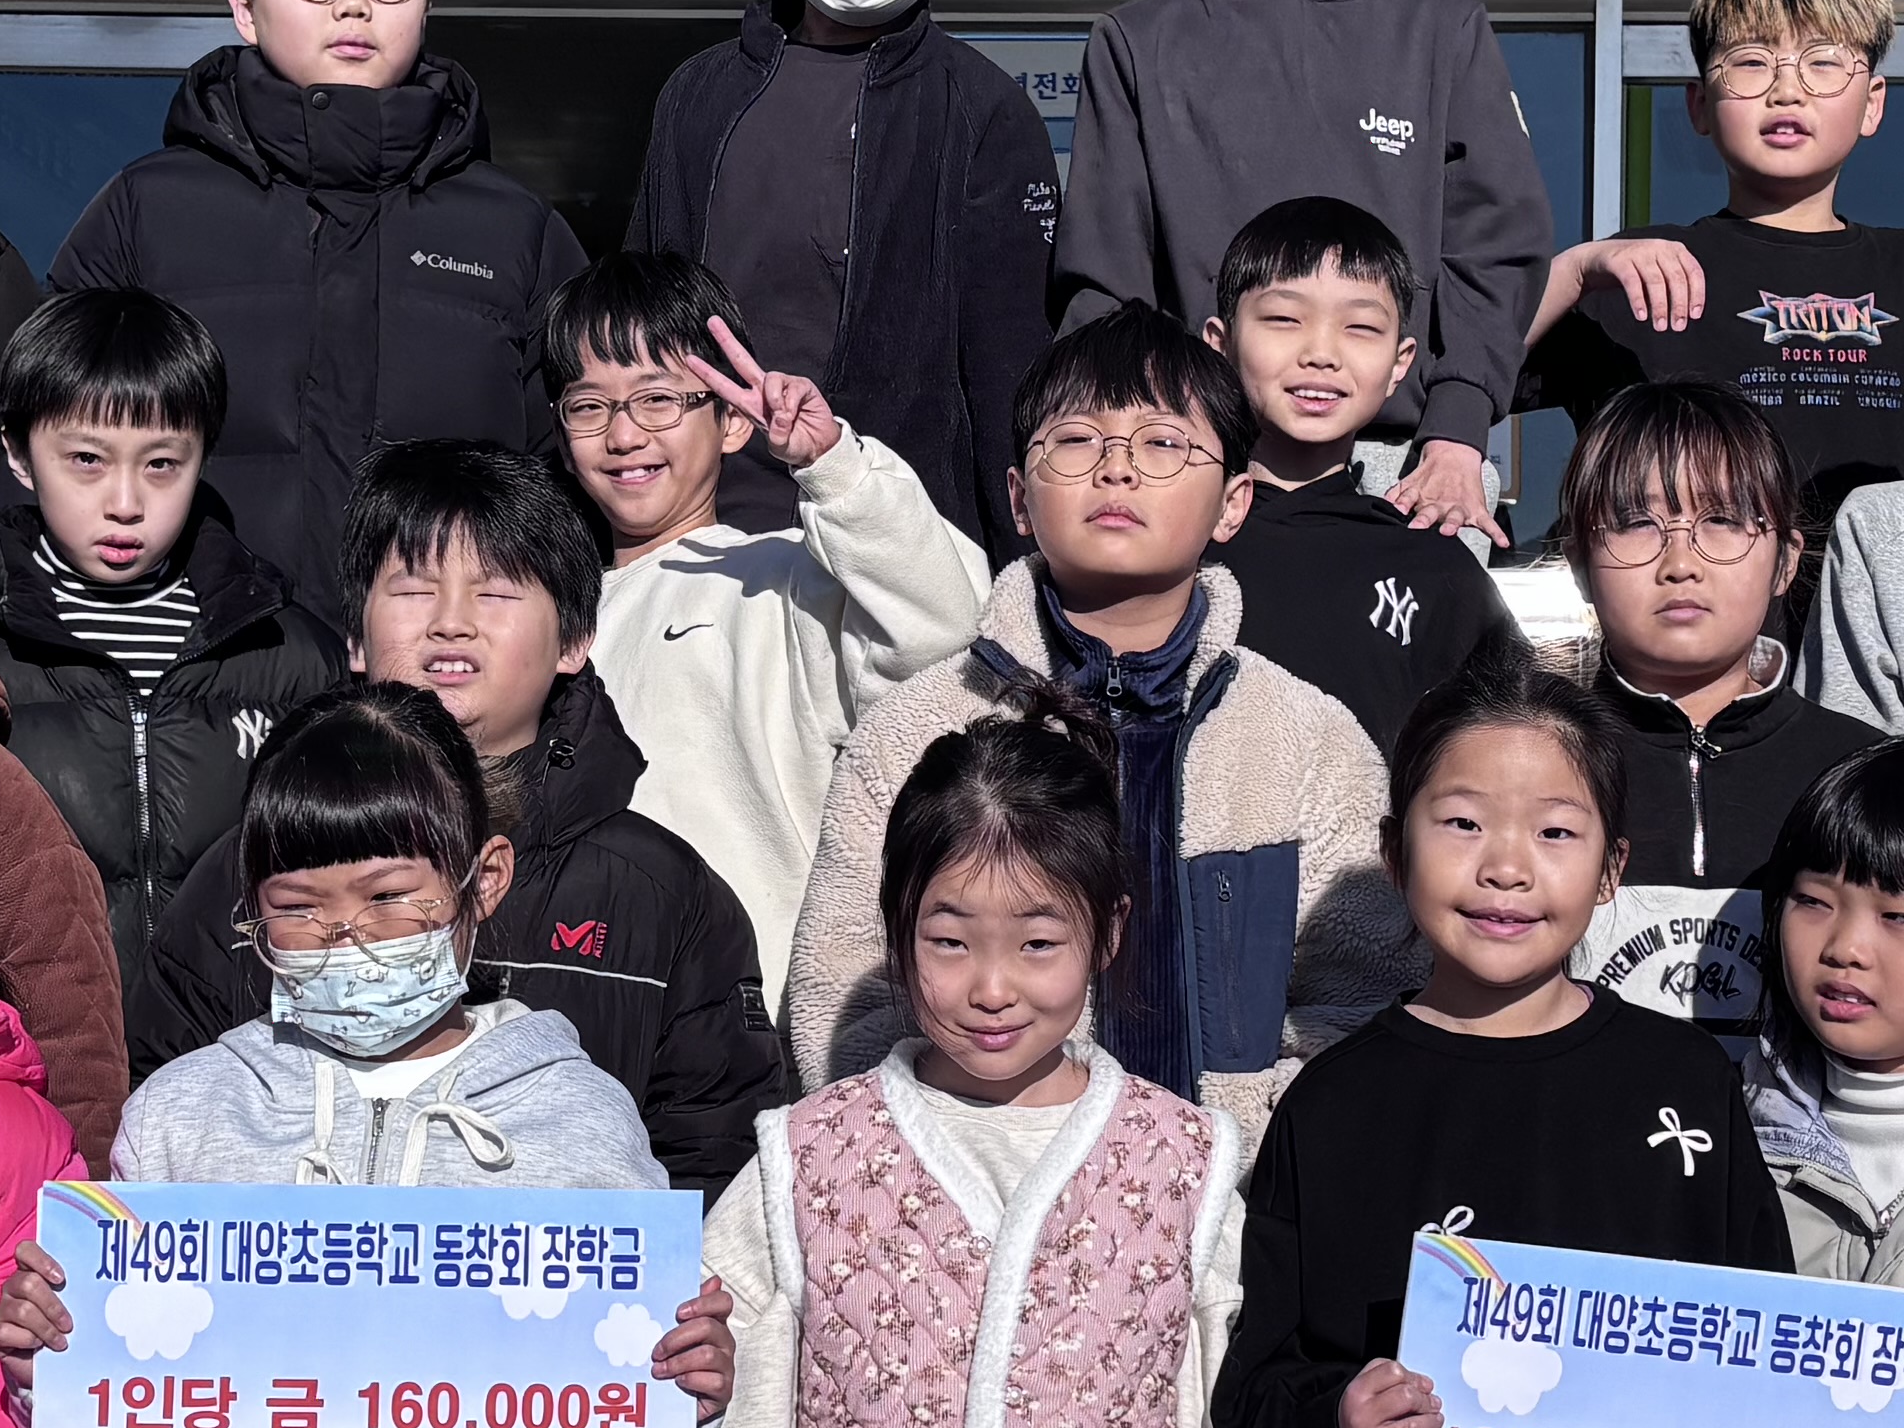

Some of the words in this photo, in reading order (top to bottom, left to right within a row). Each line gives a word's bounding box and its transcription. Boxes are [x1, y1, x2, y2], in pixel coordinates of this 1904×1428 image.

[1359, 107, 1414, 141] Jeep
[427, 253, 494, 280] Columbia
[1773, 300, 1874, 333] TRITON
[1781, 347, 1822, 362] ROCK
[1828, 349, 1868, 363] TOUR
[1595, 924, 1666, 988] PREMIUM
[1669, 917, 1740, 951] SPORTS
[95, 1217, 209, 1283] 제49회
[220, 1220, 420, 1286] 대양초등학교
[432, 1221, 531, 1288] 동창회
[542, 1224, 643, 1291] 장학금
[1456, 1276, 1566, 1345] 제49회
[1573, 1289, 1762, 1368] 대양초등학교
[1770, 1313, 1864, 1382] 동창회
